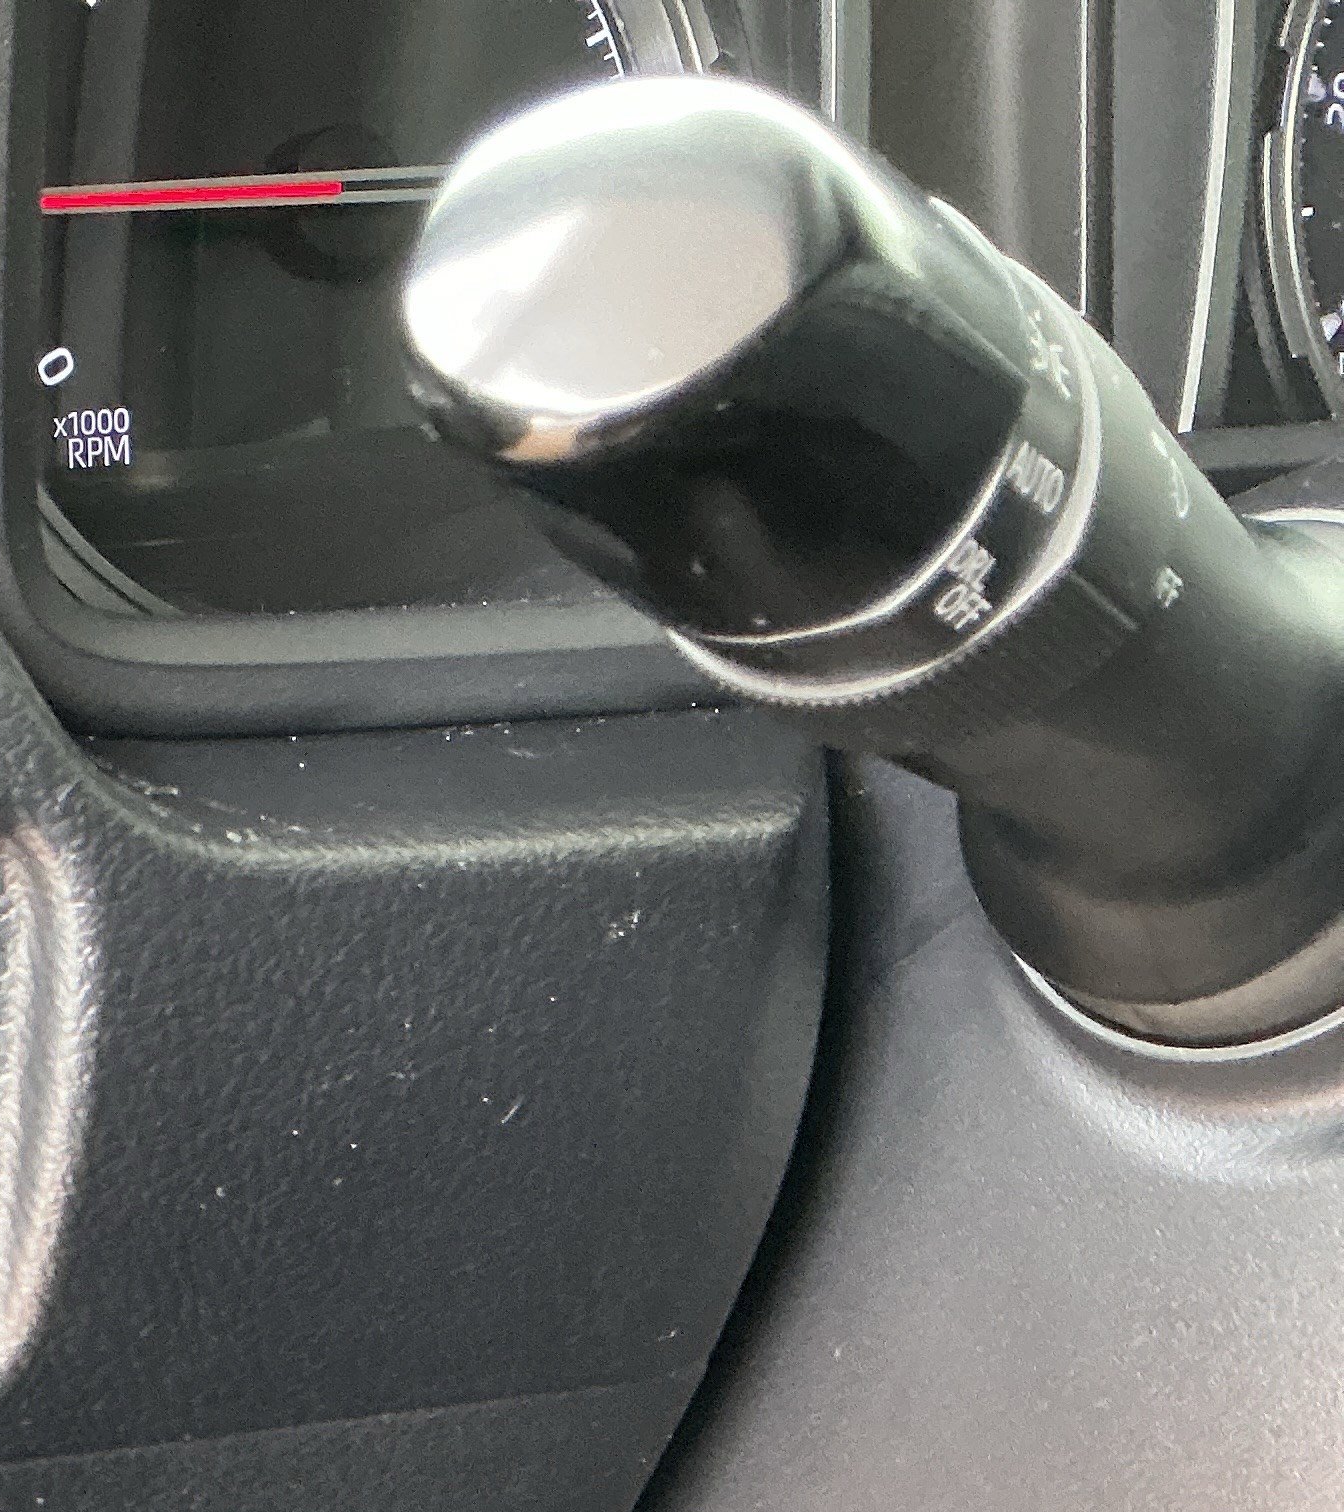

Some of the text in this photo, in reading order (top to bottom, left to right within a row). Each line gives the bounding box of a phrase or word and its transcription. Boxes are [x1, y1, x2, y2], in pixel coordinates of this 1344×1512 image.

[37, 346, 74, 386] 0
[52, 406, 130, 438] x1000
[67, 434, 130, 469] RPM
[1006, 440, 1065, 514] AUTO
[933, 583, 993, 631] OFF
